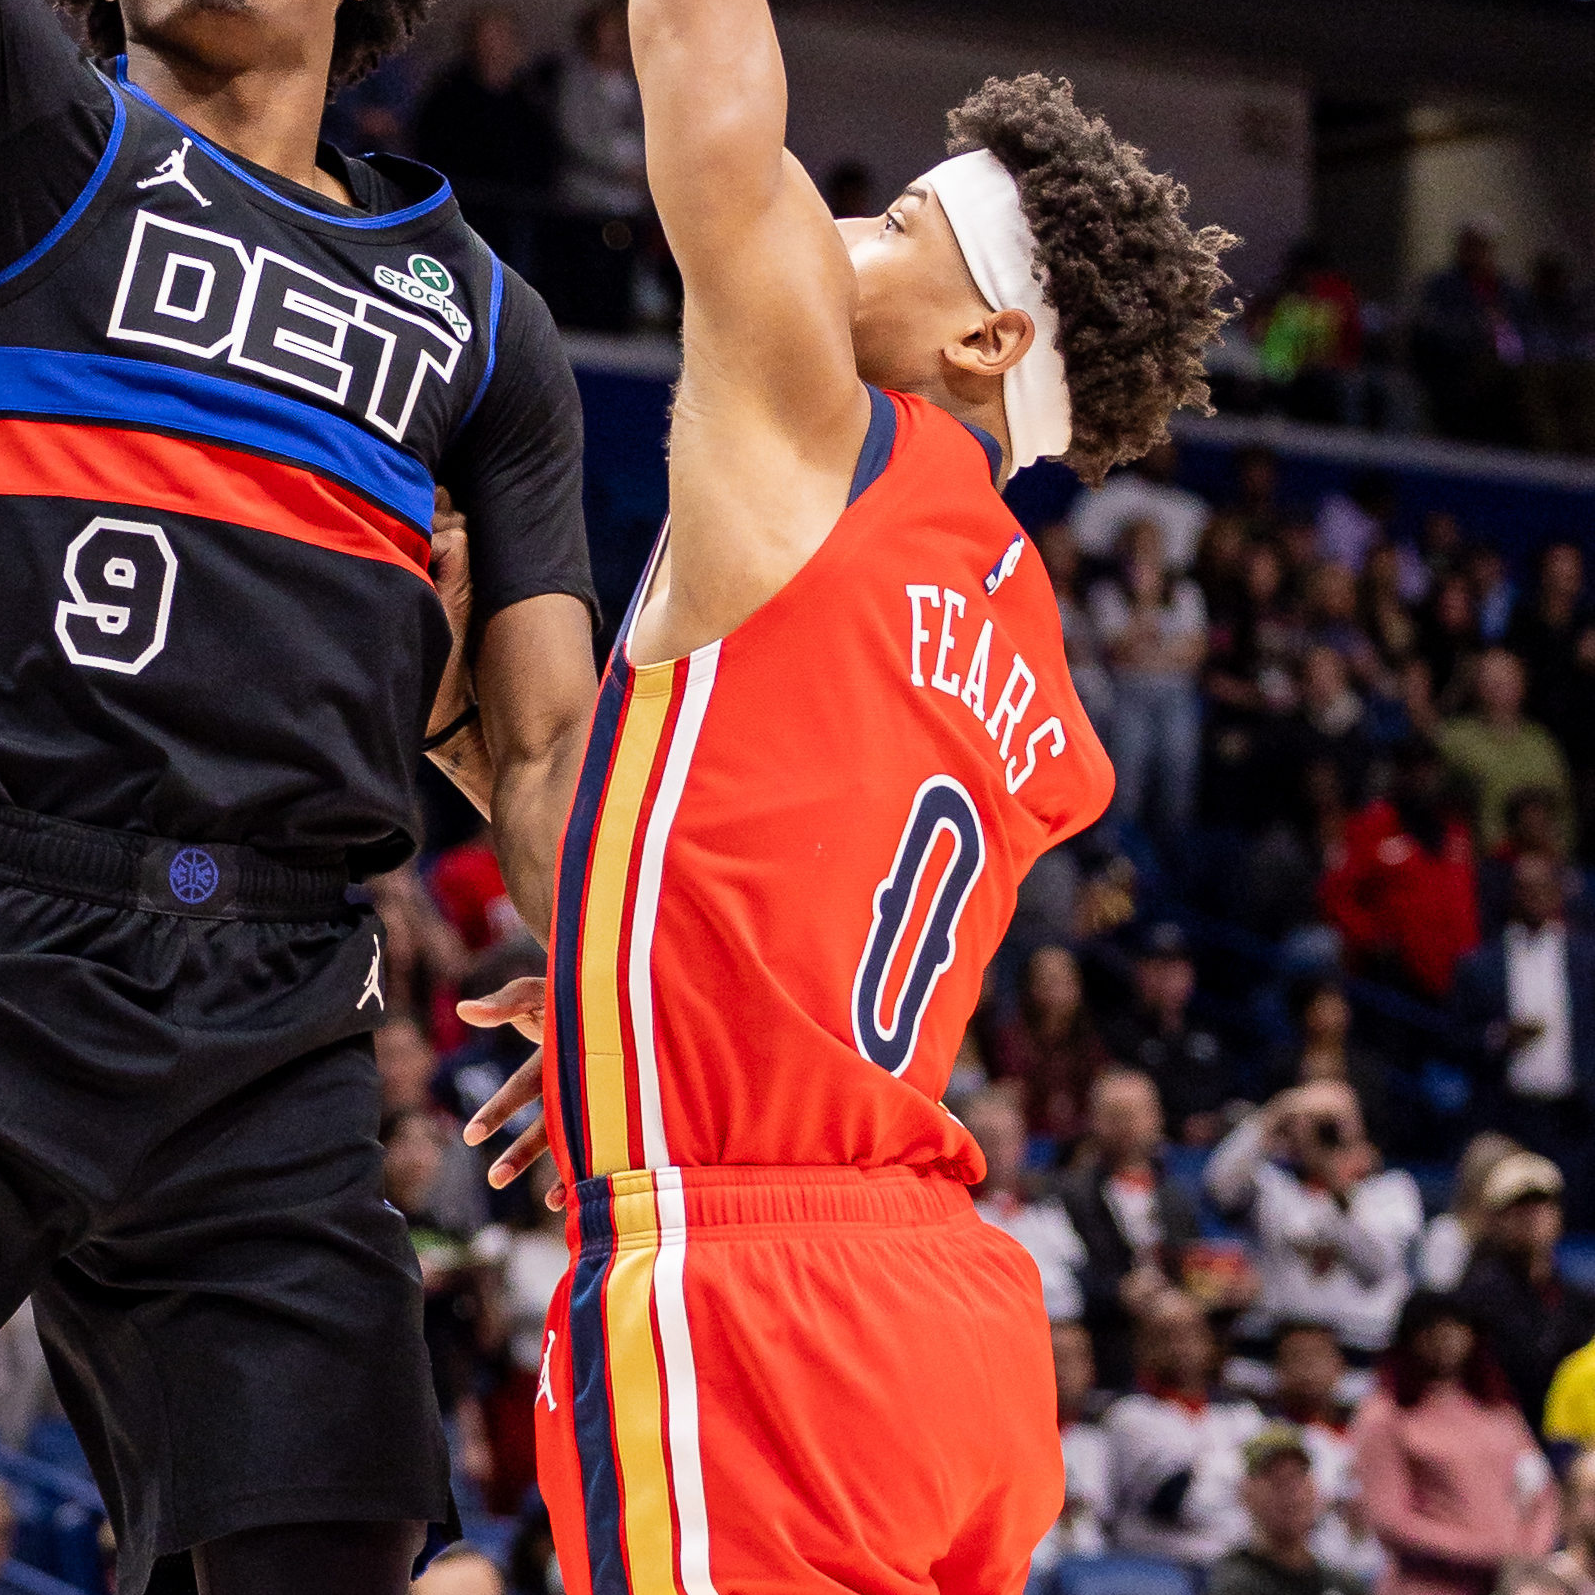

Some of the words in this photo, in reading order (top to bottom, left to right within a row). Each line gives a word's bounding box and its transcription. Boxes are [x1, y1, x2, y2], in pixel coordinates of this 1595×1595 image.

[107, 210, 463, 442] DET
[55, 516, 178, 675] 9
[905, 583, 1066, 795] FEARS
[851, 773, 985, 1077] 0
